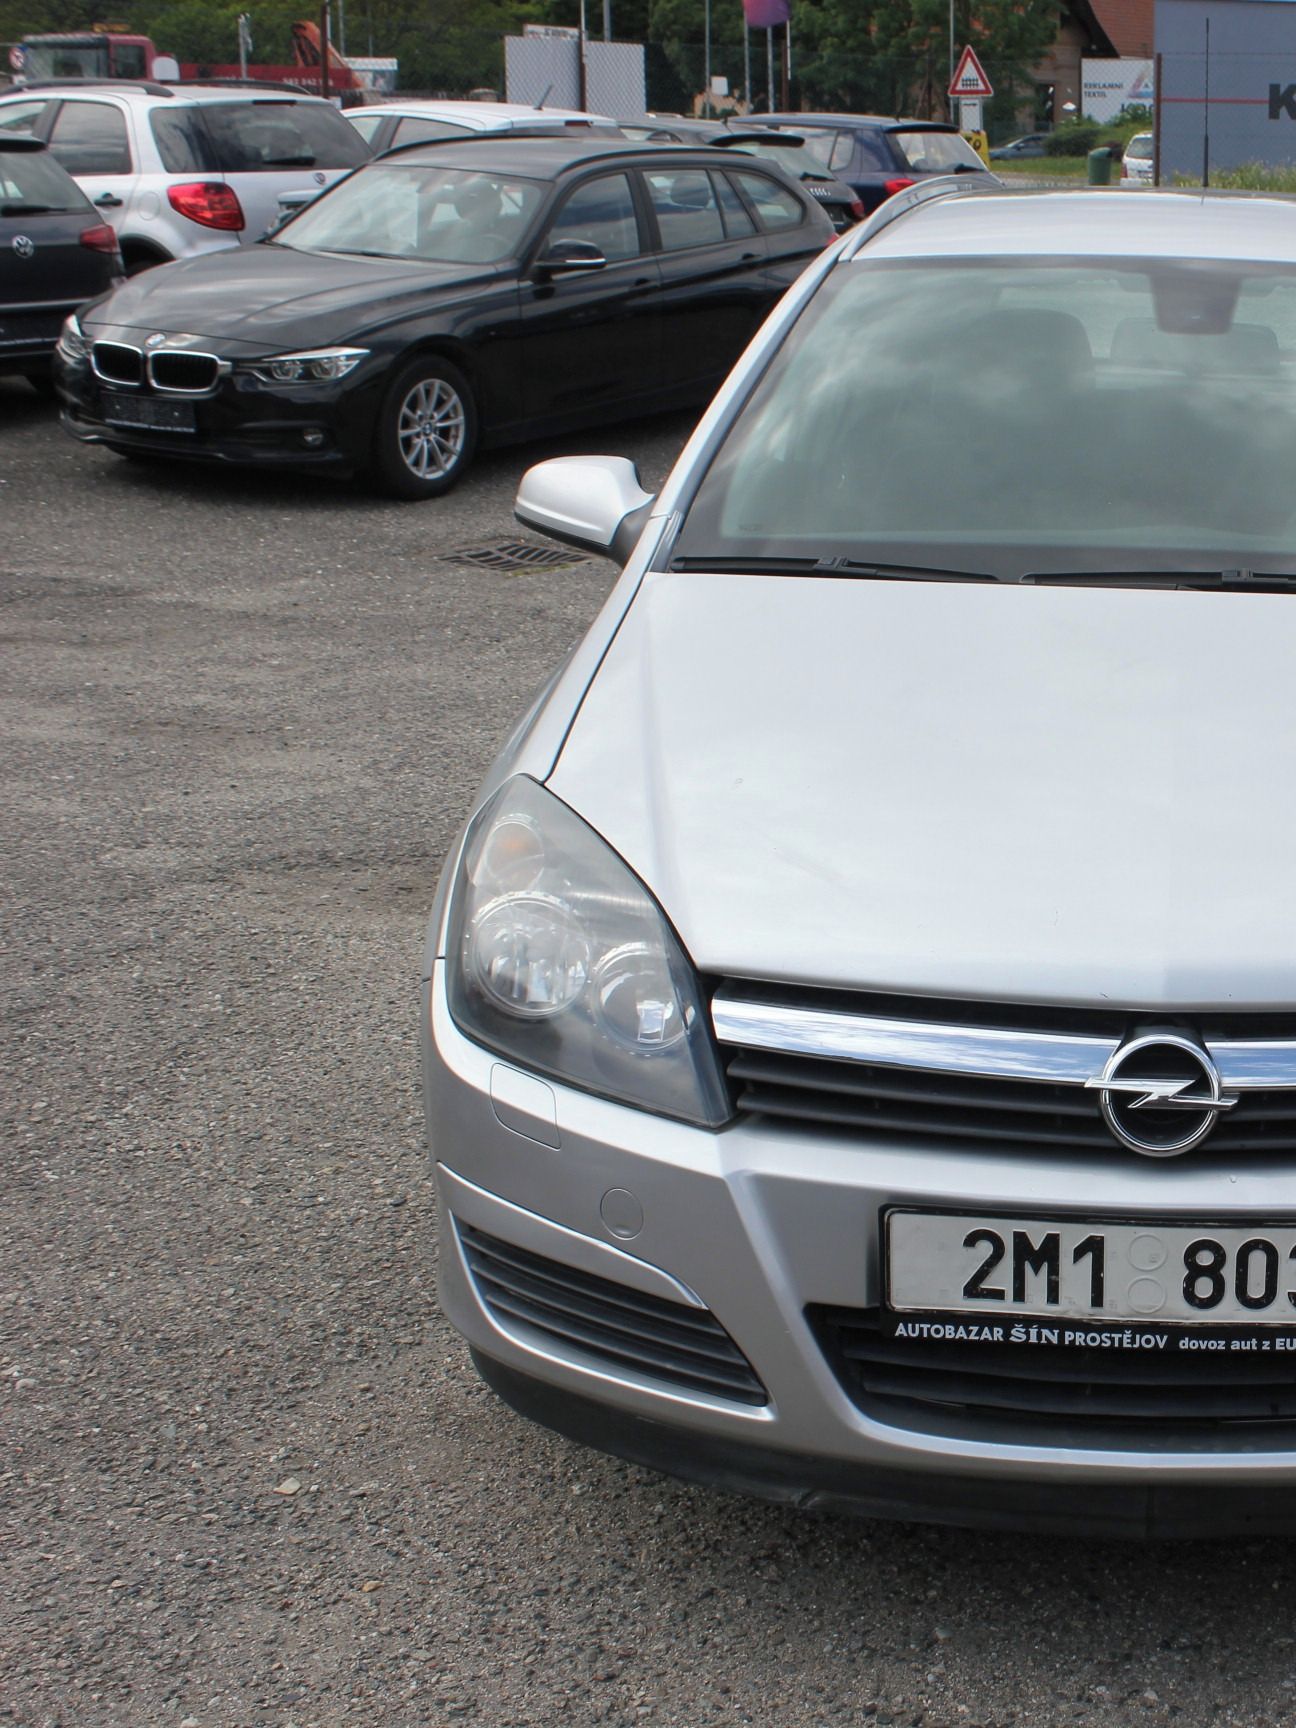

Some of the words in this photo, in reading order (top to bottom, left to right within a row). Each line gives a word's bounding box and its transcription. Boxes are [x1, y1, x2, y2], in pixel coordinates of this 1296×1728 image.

[963, 1228, 1105, 1308] 2M1
[895, 1322, 1004, 1342] AUTOBAZAR
[1010, 1324, 1060, 1345] ŠÍN
[1065, 1330, 1168, 1349] PROSTĚJOV
[1178, 1336, 1226, 1350] dovoz
[1230, 1338, 1258, 1350] aut
[1262, 1340, 1271, 1350] z
